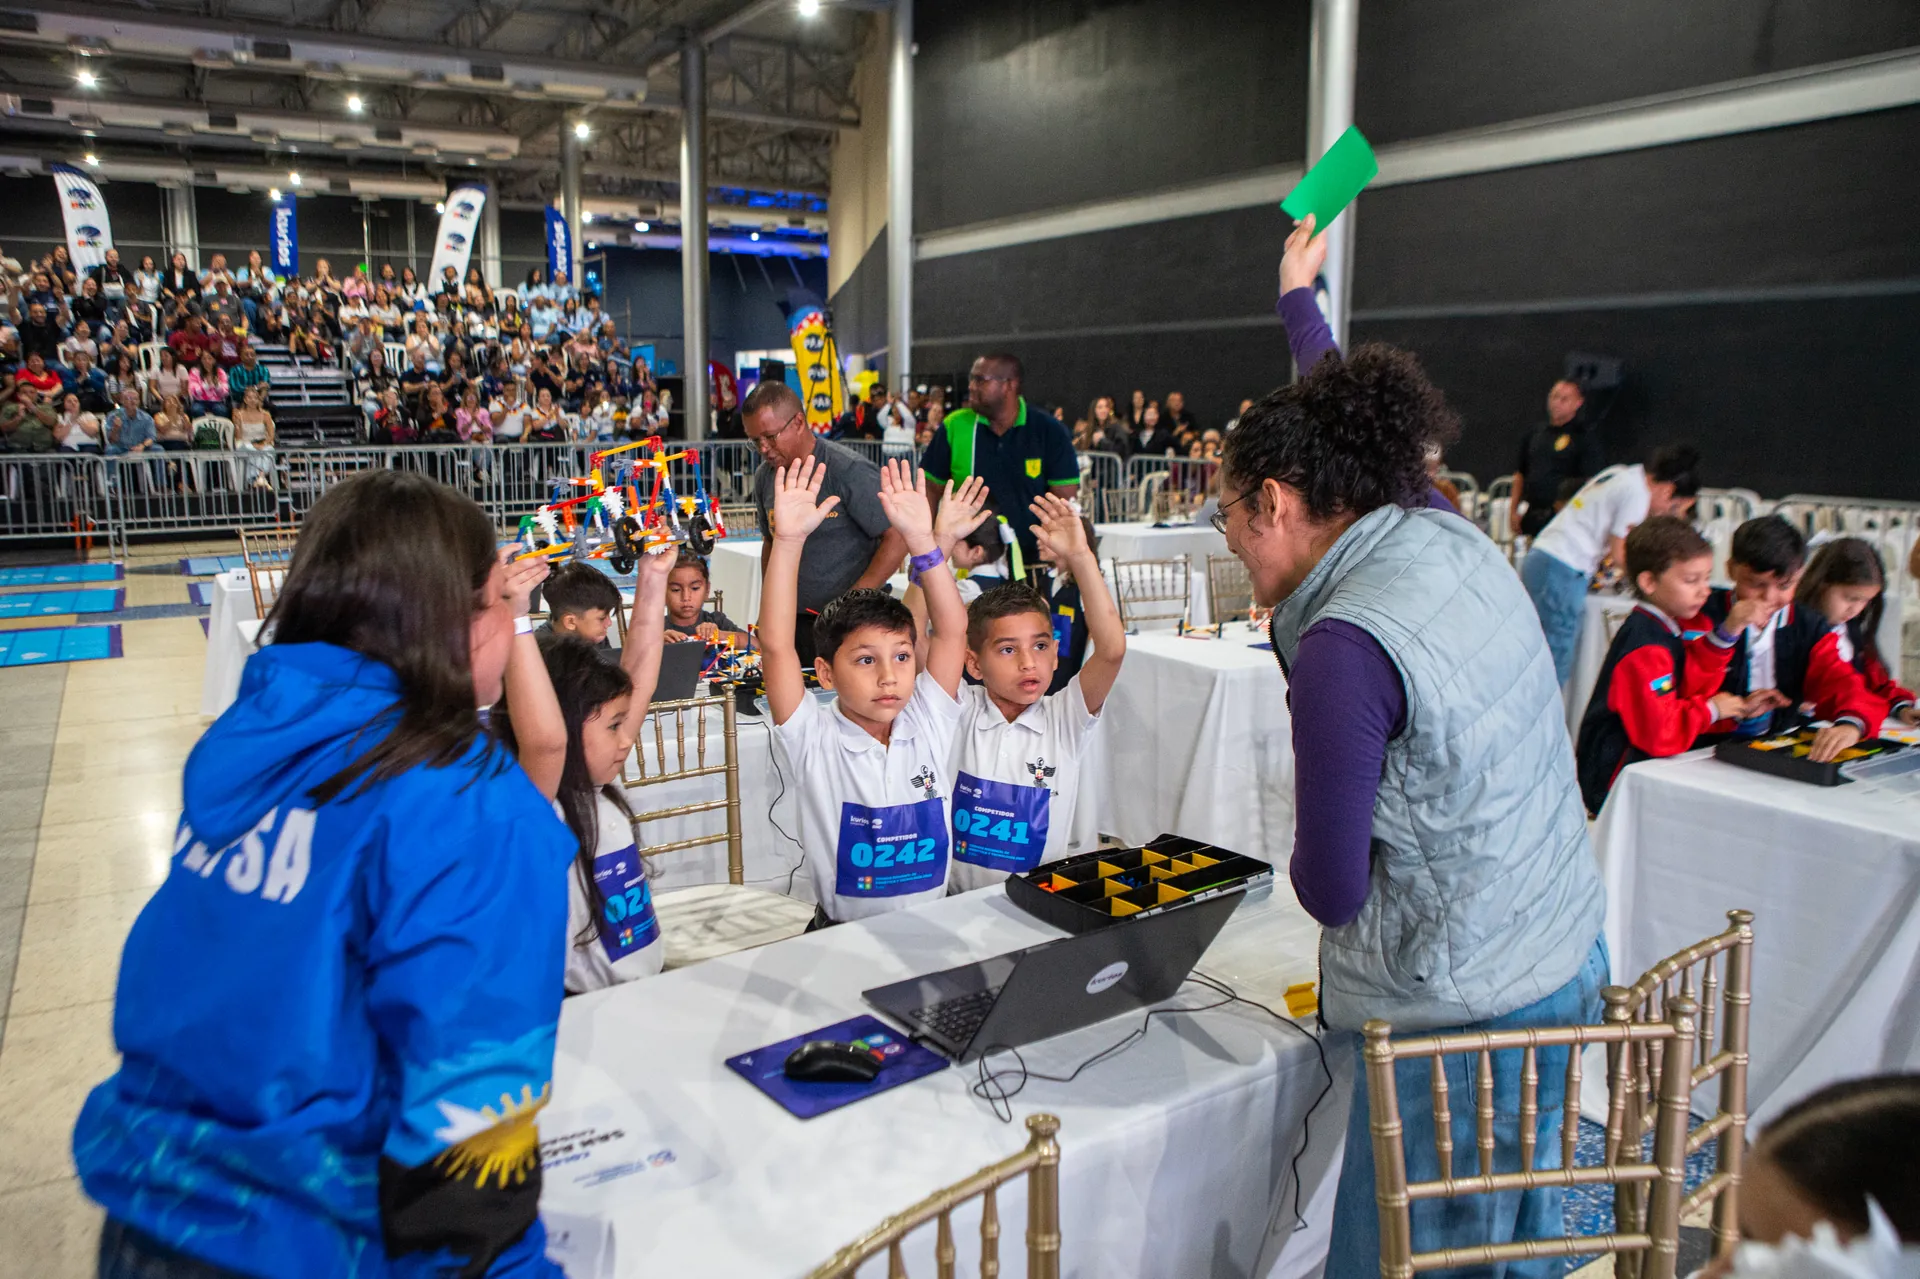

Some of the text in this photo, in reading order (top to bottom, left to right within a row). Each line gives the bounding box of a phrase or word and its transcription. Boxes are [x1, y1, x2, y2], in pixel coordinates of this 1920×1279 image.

[974, 806, 1015, 818] COMPETIDOR
[954, 808, 1029, 845] 0241
[876, 833, 918, 843] COMPETIDOR
[851, 837, 935, 868] 0242
